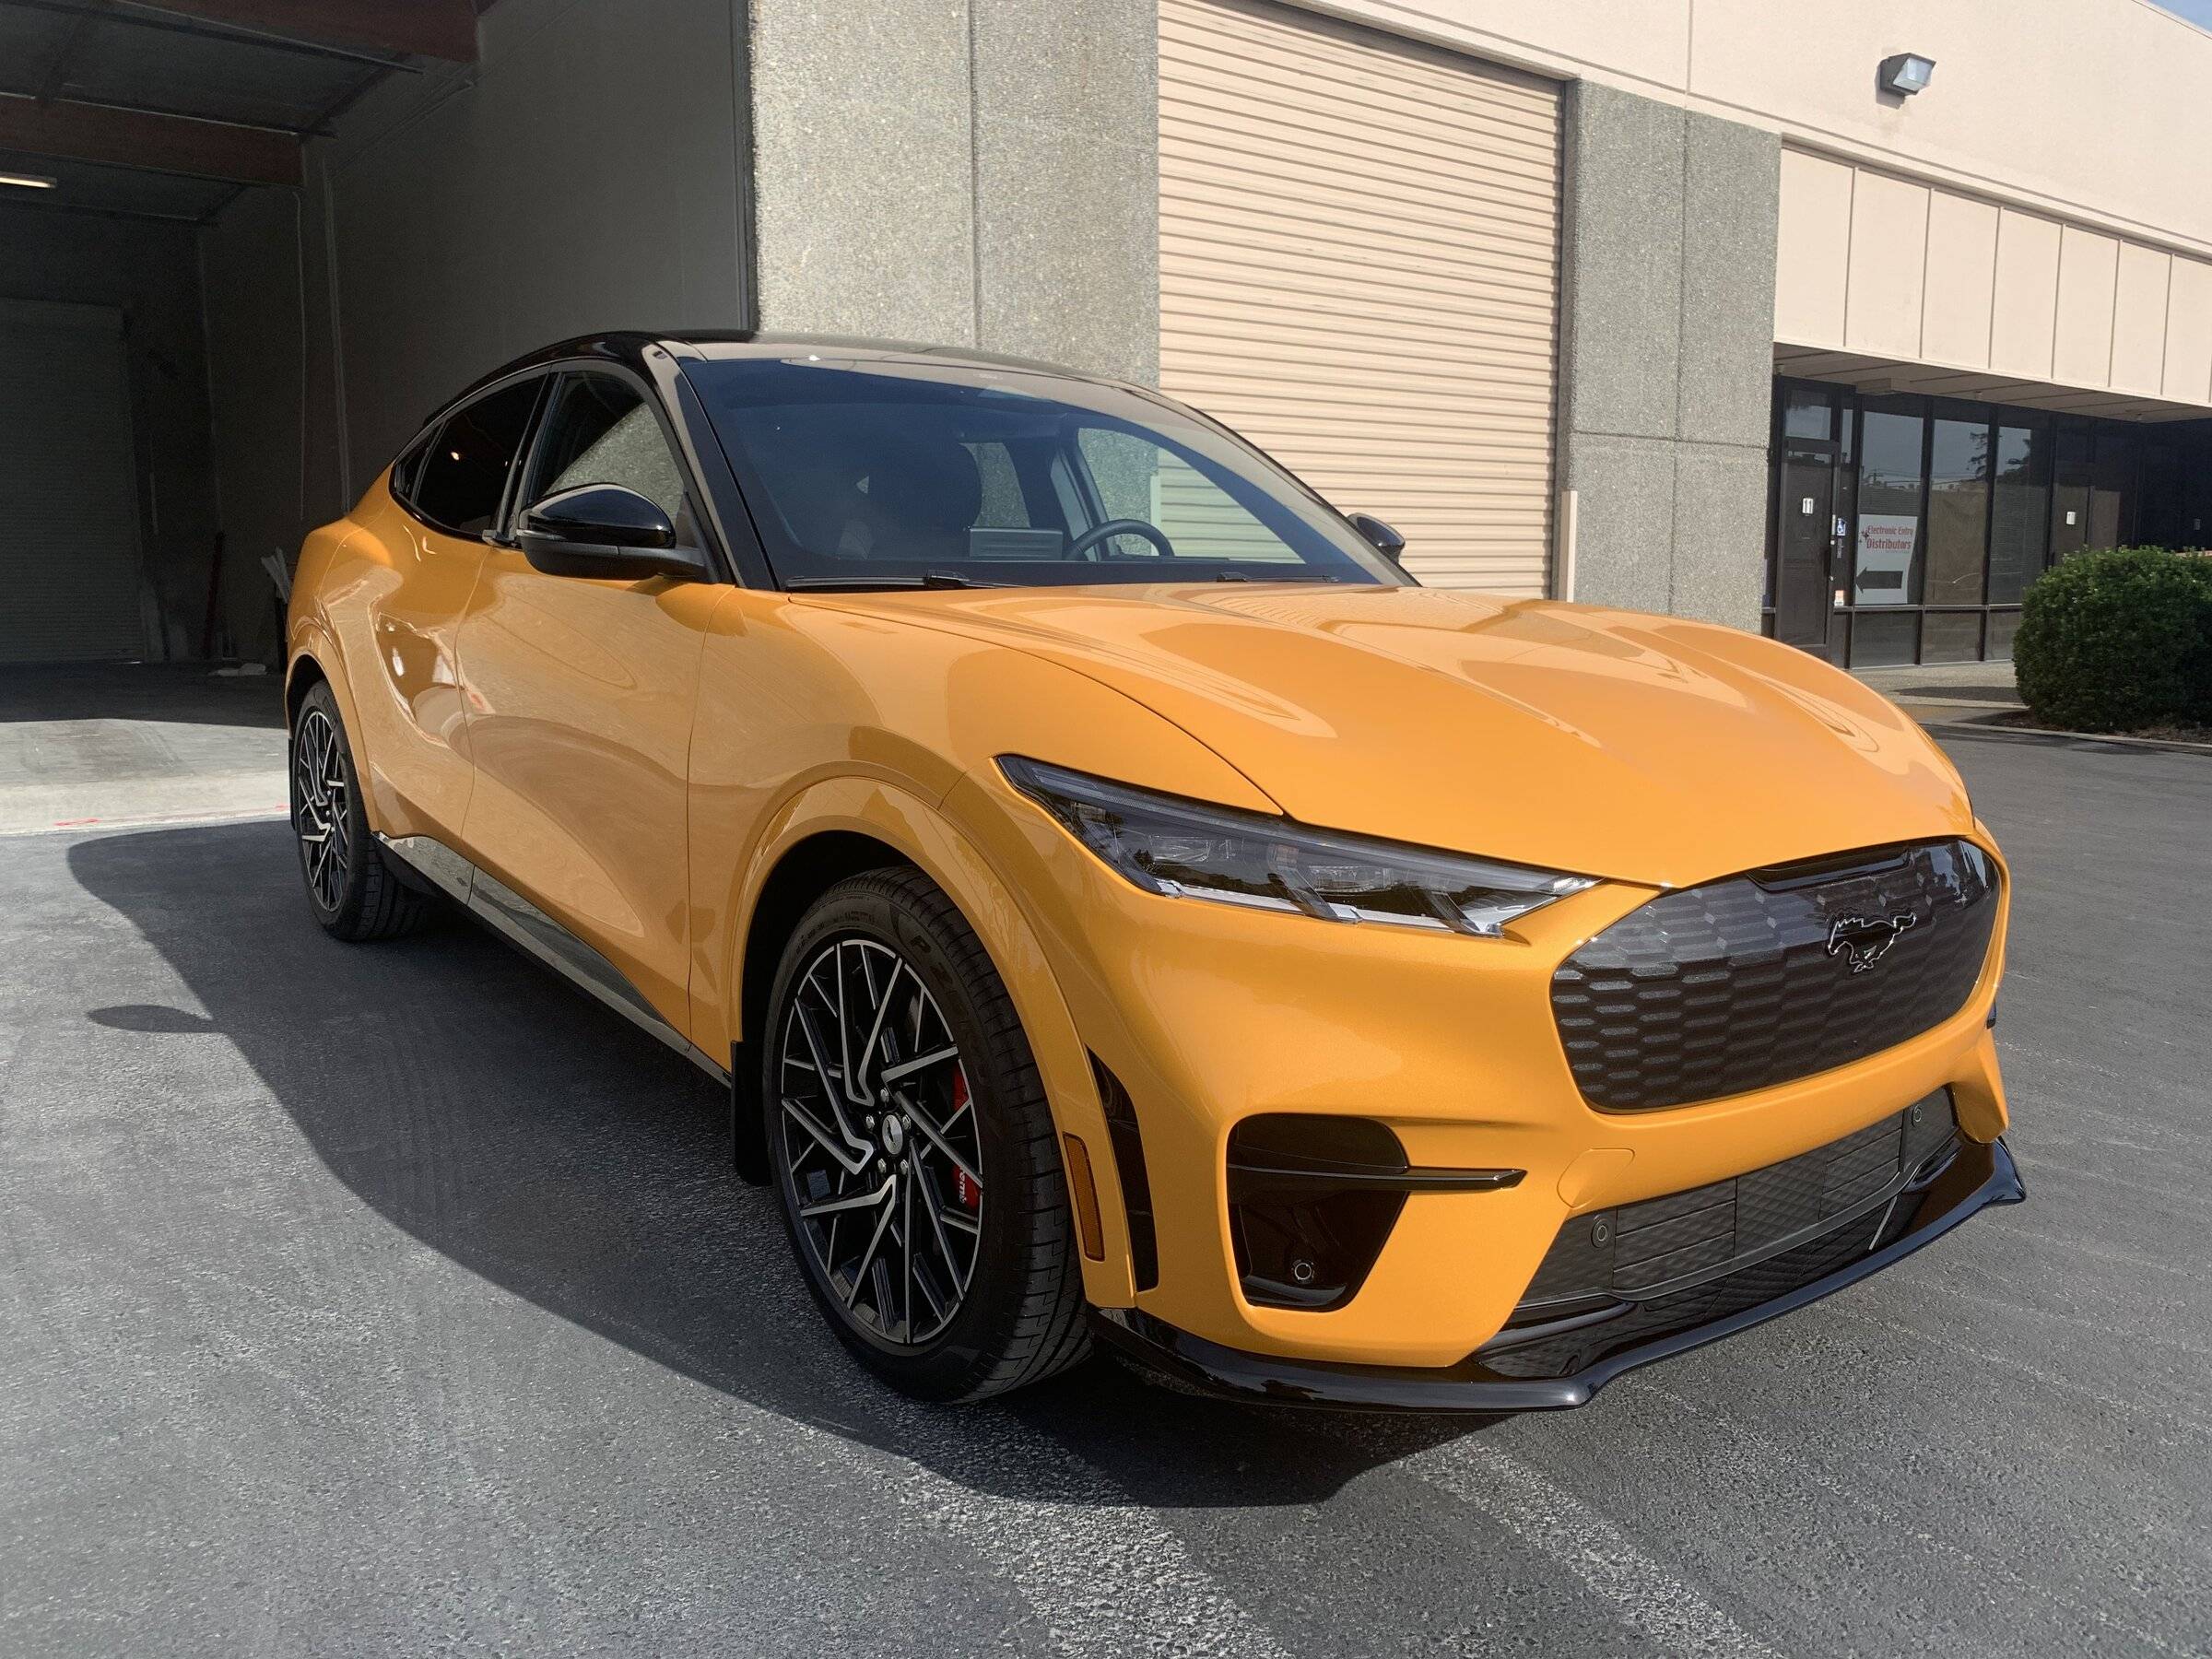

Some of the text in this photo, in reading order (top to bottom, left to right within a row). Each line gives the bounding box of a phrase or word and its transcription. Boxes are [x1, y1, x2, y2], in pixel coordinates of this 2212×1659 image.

[1867, 525, 1914, 537] Electronic Entry
[1866, 538, 1912, 549] Distributors
